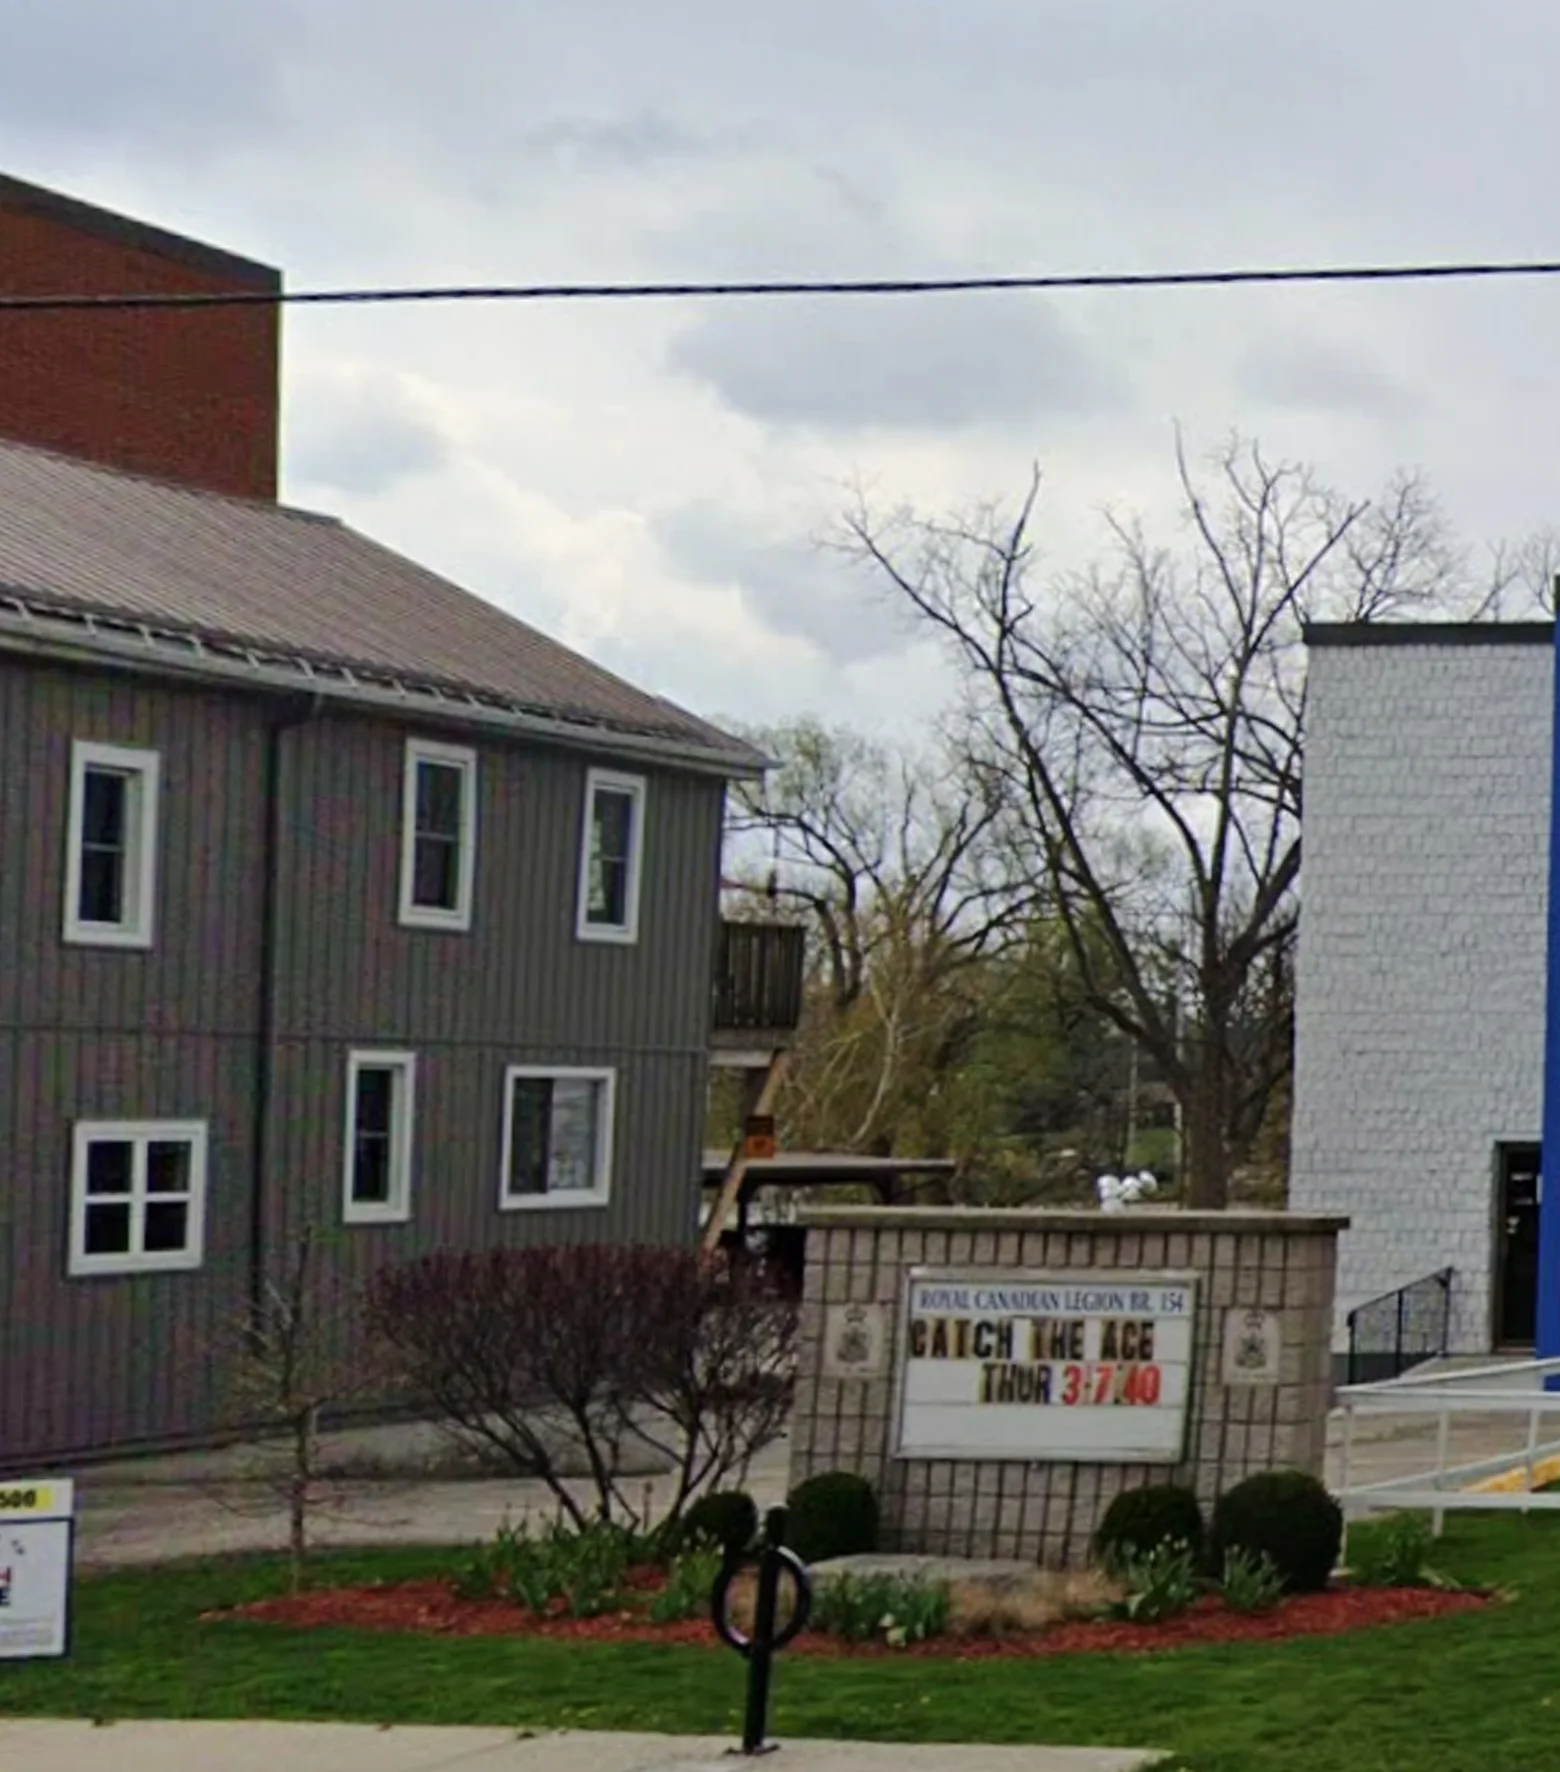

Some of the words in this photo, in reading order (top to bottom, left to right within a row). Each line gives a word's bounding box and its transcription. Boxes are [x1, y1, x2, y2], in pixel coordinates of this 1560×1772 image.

[920, 1289, 970, 1310] ROYAL
[974, 1289, 1060, 1312] CANADIAN
[1064, 1290, 1124, 1312] LEGION
[1161, 1291, 1184, 1313] 154
[911, 1318, 1013, 1360] CATCH
[1031, 1318, 1085, 1361] THE
[1101, 1319, 1155, 1362] ACE
[982, 1363, 1052, 1405] THUR
